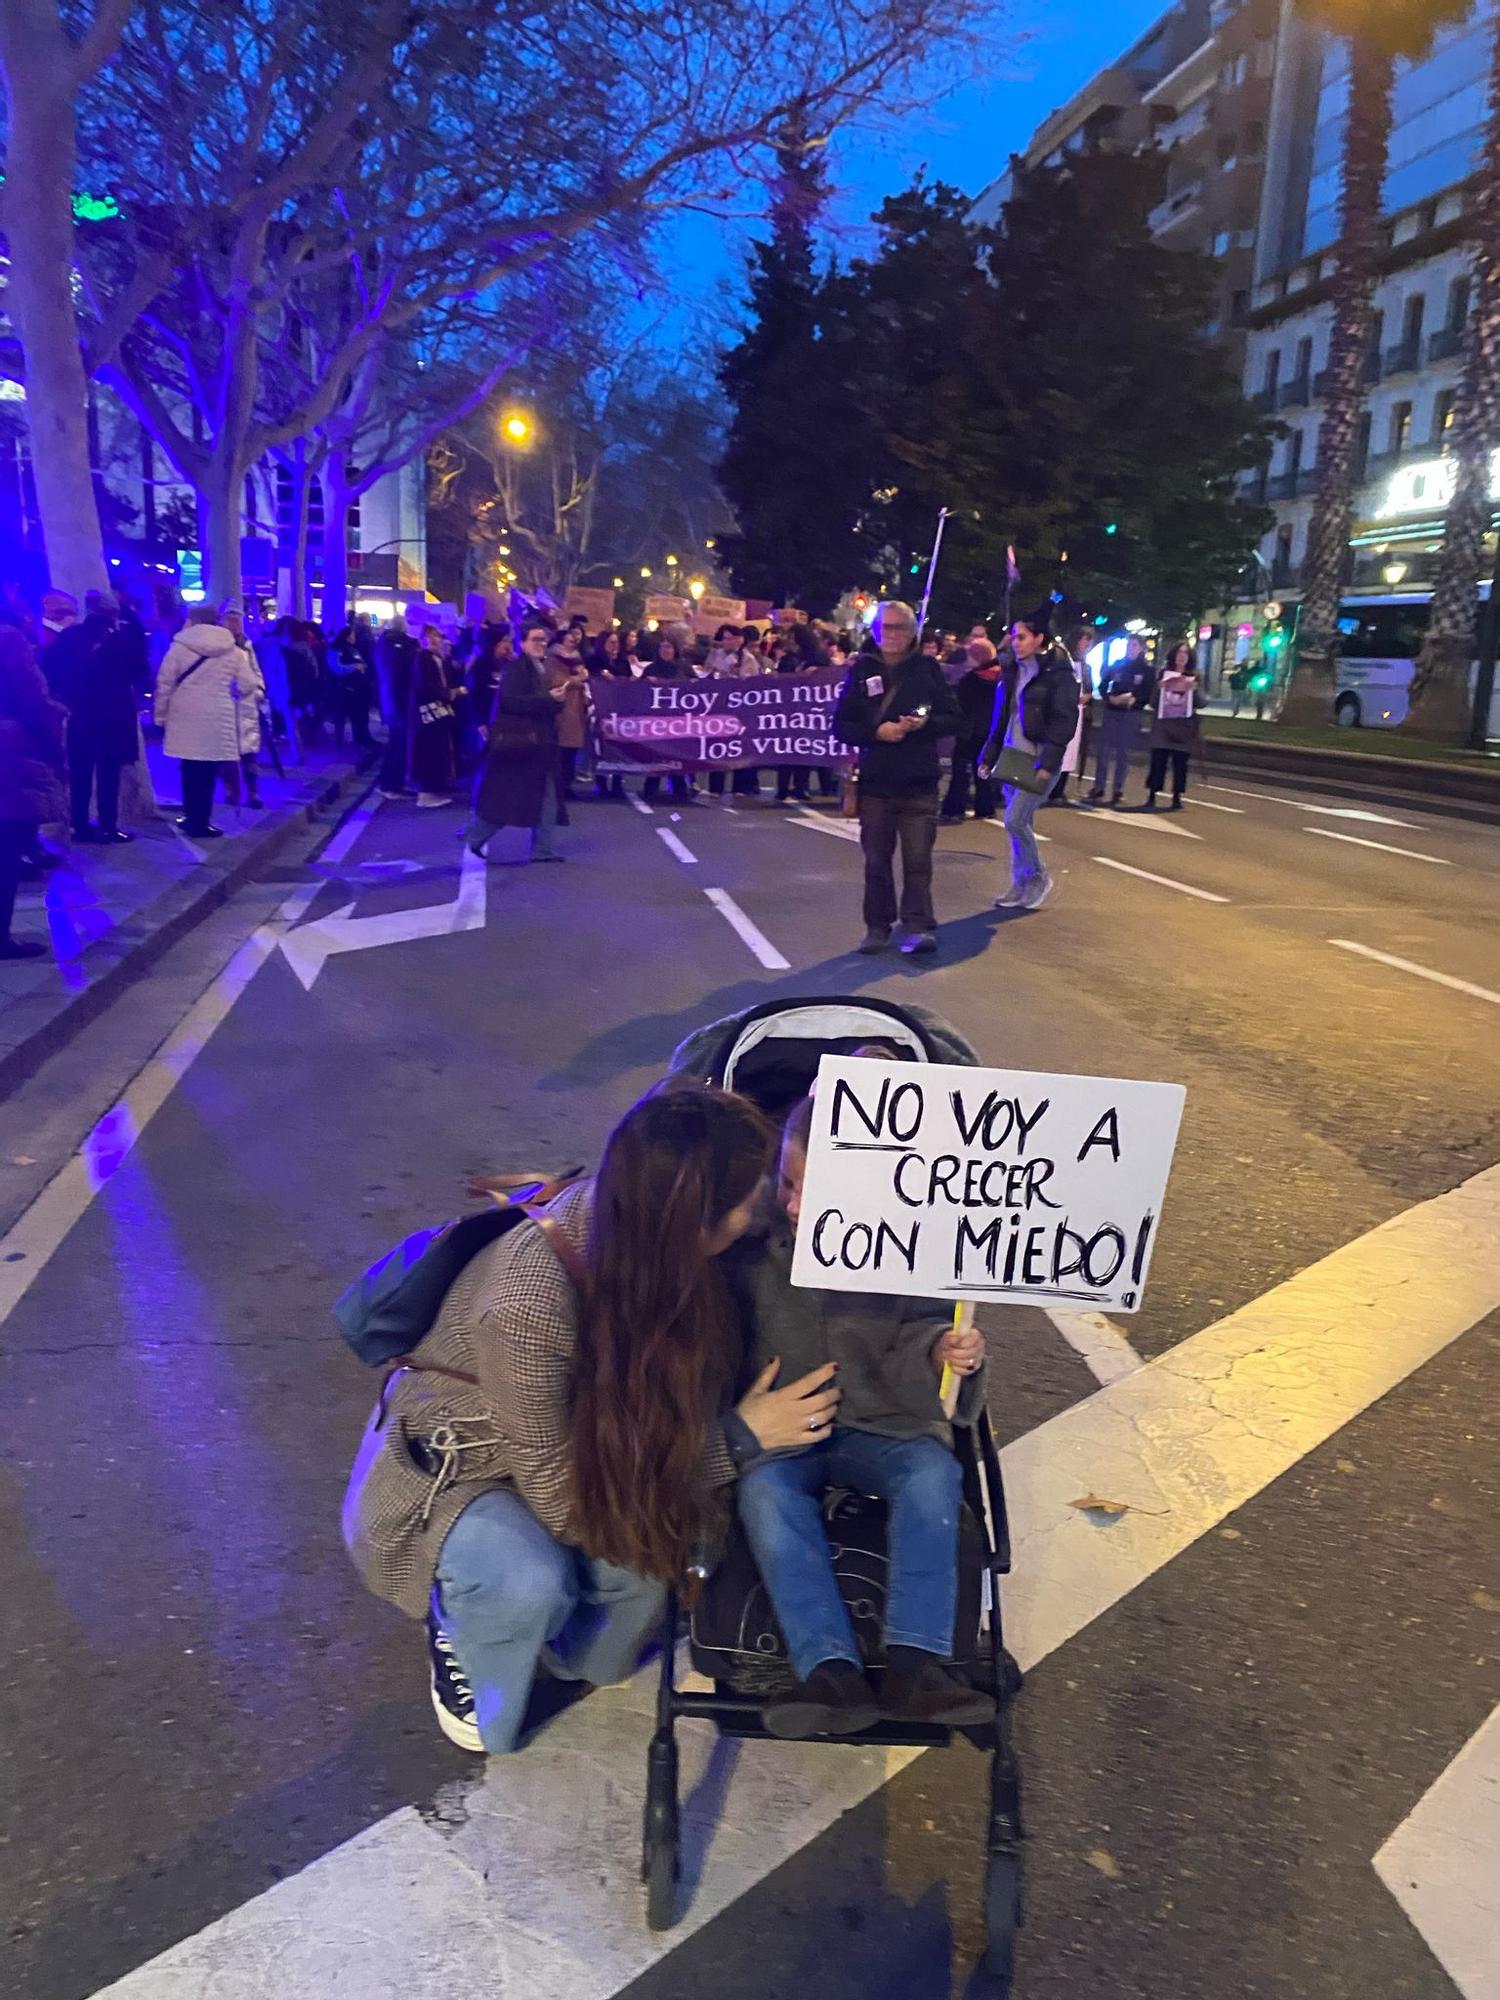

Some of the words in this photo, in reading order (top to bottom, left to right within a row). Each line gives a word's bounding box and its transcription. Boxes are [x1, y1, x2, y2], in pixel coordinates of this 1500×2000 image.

[651, 687, 718, 716] Hoy
[727, 688, 782, 706] son
[602, 712, 747, 737] derechos,
[698, 736, 743, 760] los
[830, 1077, 924, 1142] NO
[949, 1089, 1050, 1156] VOY
[1076, 1107, 1121, 1163] A
[893, 1153, 1063, 1210] CRECER
[811, 1208, 921, 1274] CON
